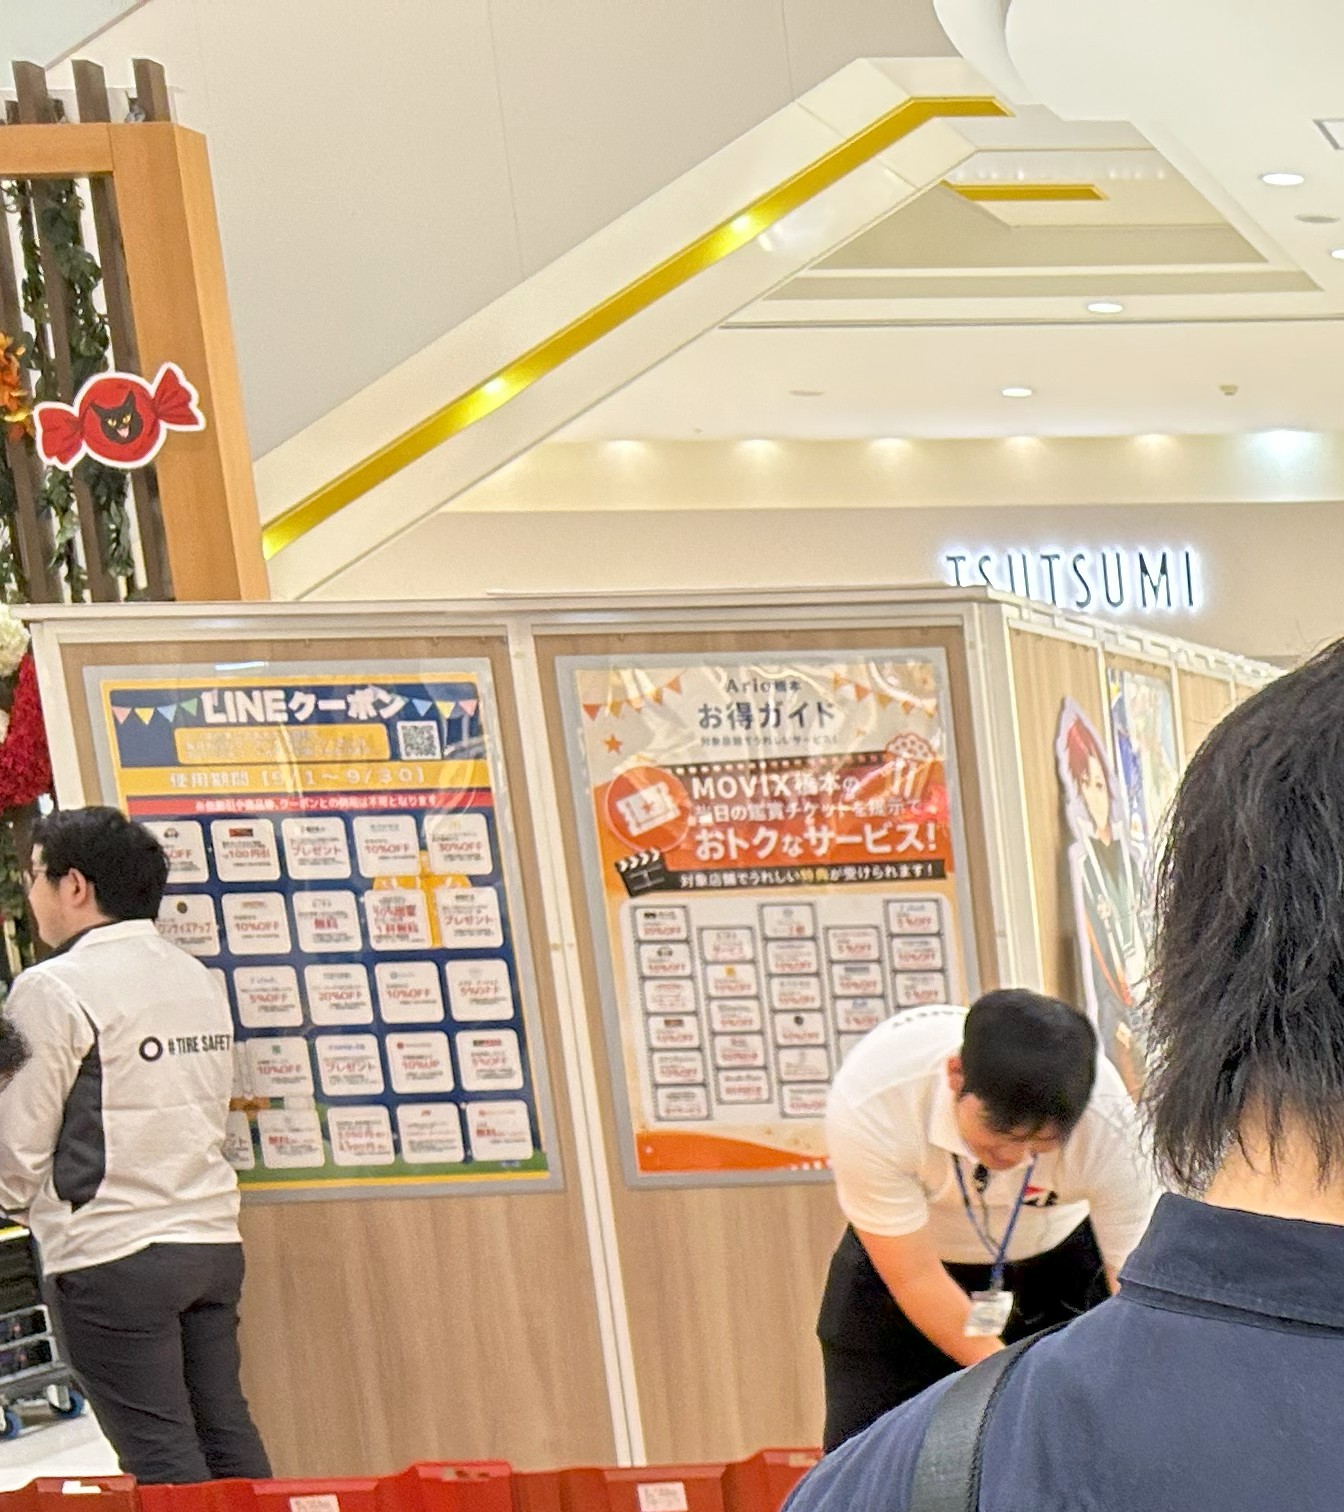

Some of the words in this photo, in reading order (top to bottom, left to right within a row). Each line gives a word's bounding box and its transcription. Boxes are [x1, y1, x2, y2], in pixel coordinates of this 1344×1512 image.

[946, 551, 1195, 608] TSUTSUMI
[201, 686, 402, 724] LINEクーポン
[698, 701, 835, 730] お得ガイド
[201, 1033, 232, 1053] SAFET
